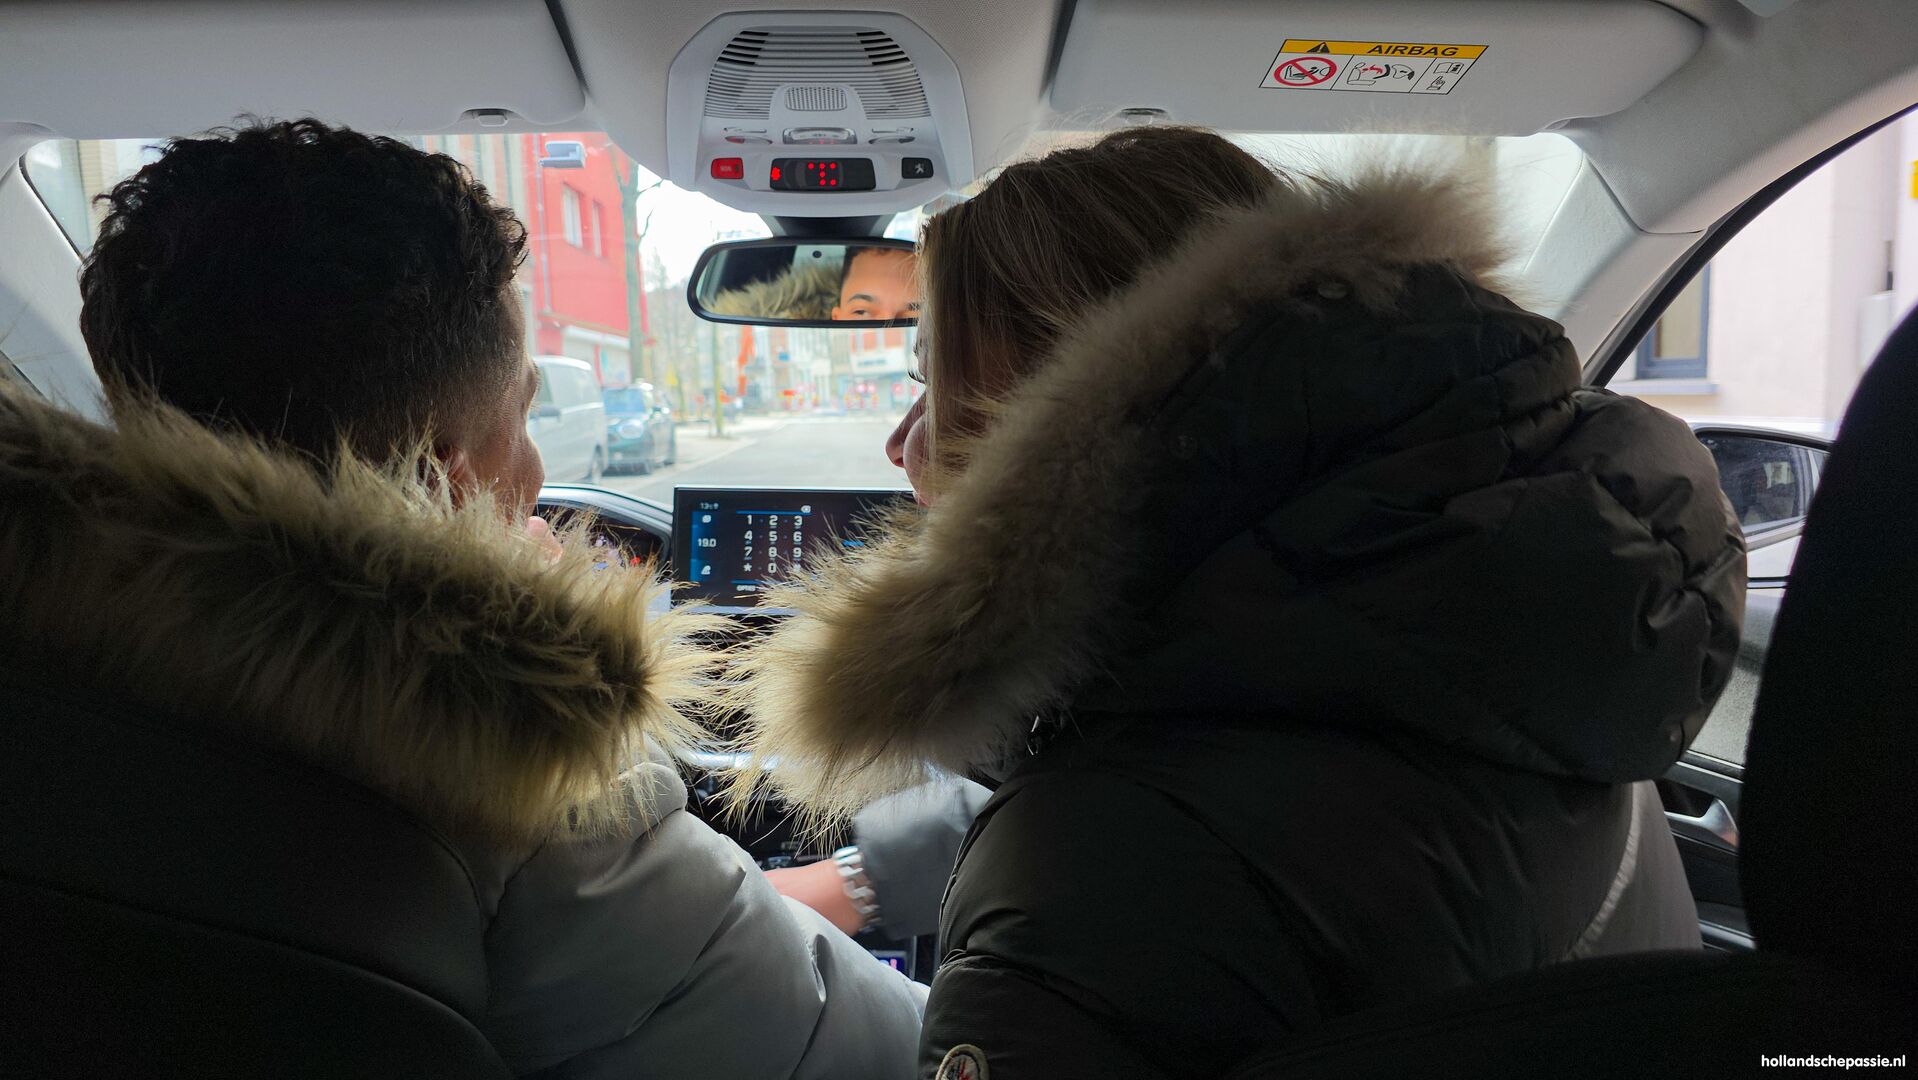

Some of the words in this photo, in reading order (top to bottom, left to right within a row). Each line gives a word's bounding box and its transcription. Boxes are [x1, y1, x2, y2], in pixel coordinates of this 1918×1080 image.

[1367, 44, 1459, 56] AIRBAG
[747, 514, 752, 525] 1
[769, 514, 778, 526] 2
[794, 515, 803, 526] 3
[744, 530, 753, 541] 4
[768, 530, 778, 542] 5
[793, 531, 802, 542] 6
[697, 538, 717, 548] 19.0
[744, 546, 753, 557] 7
[768, 546, 777, 558] 8
[793, 547, 802, 558] 9
